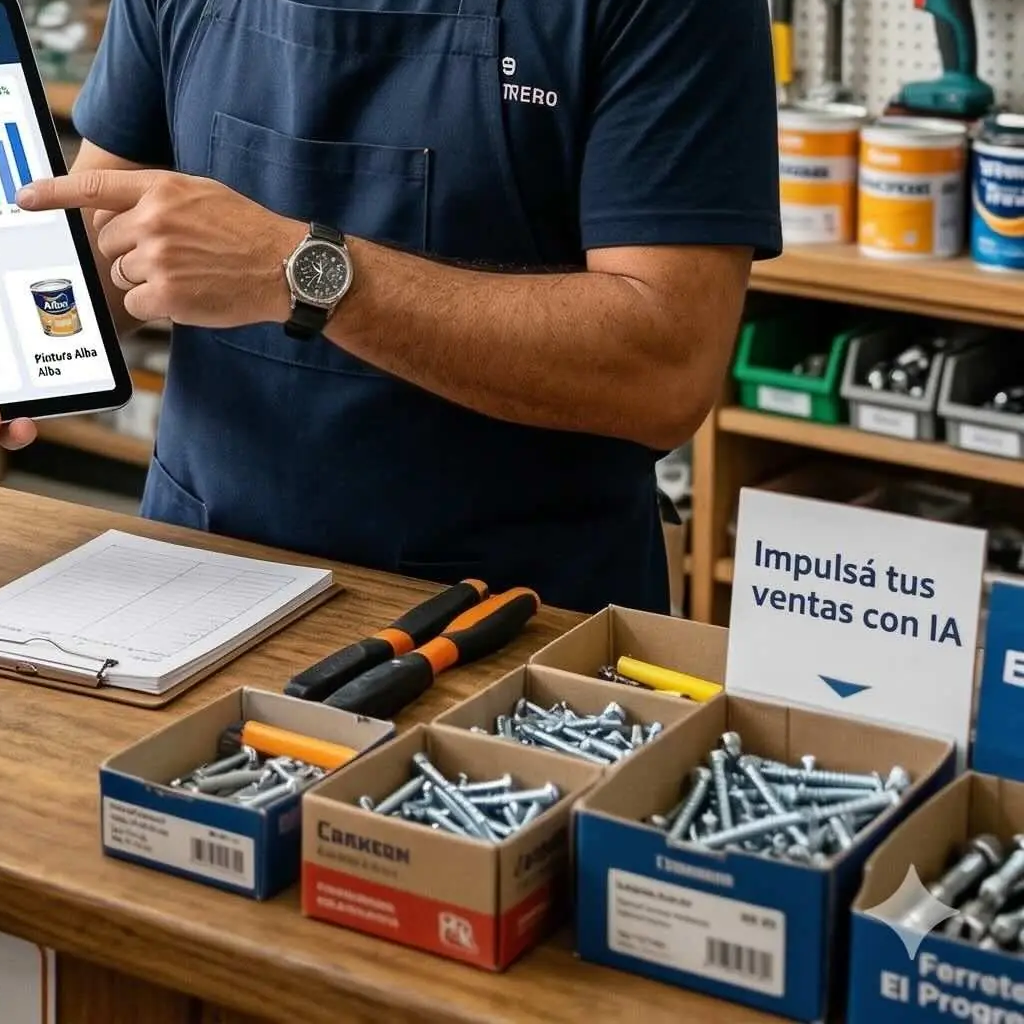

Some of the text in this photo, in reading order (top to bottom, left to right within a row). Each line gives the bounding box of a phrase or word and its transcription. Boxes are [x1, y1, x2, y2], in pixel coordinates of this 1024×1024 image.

[38, 367, 62, 378] Alba
[754, 539, 936, 599] Impulsá tus
[751, 584, 963, 647] ventas con IA
[880, 969, 910, 1004] El
